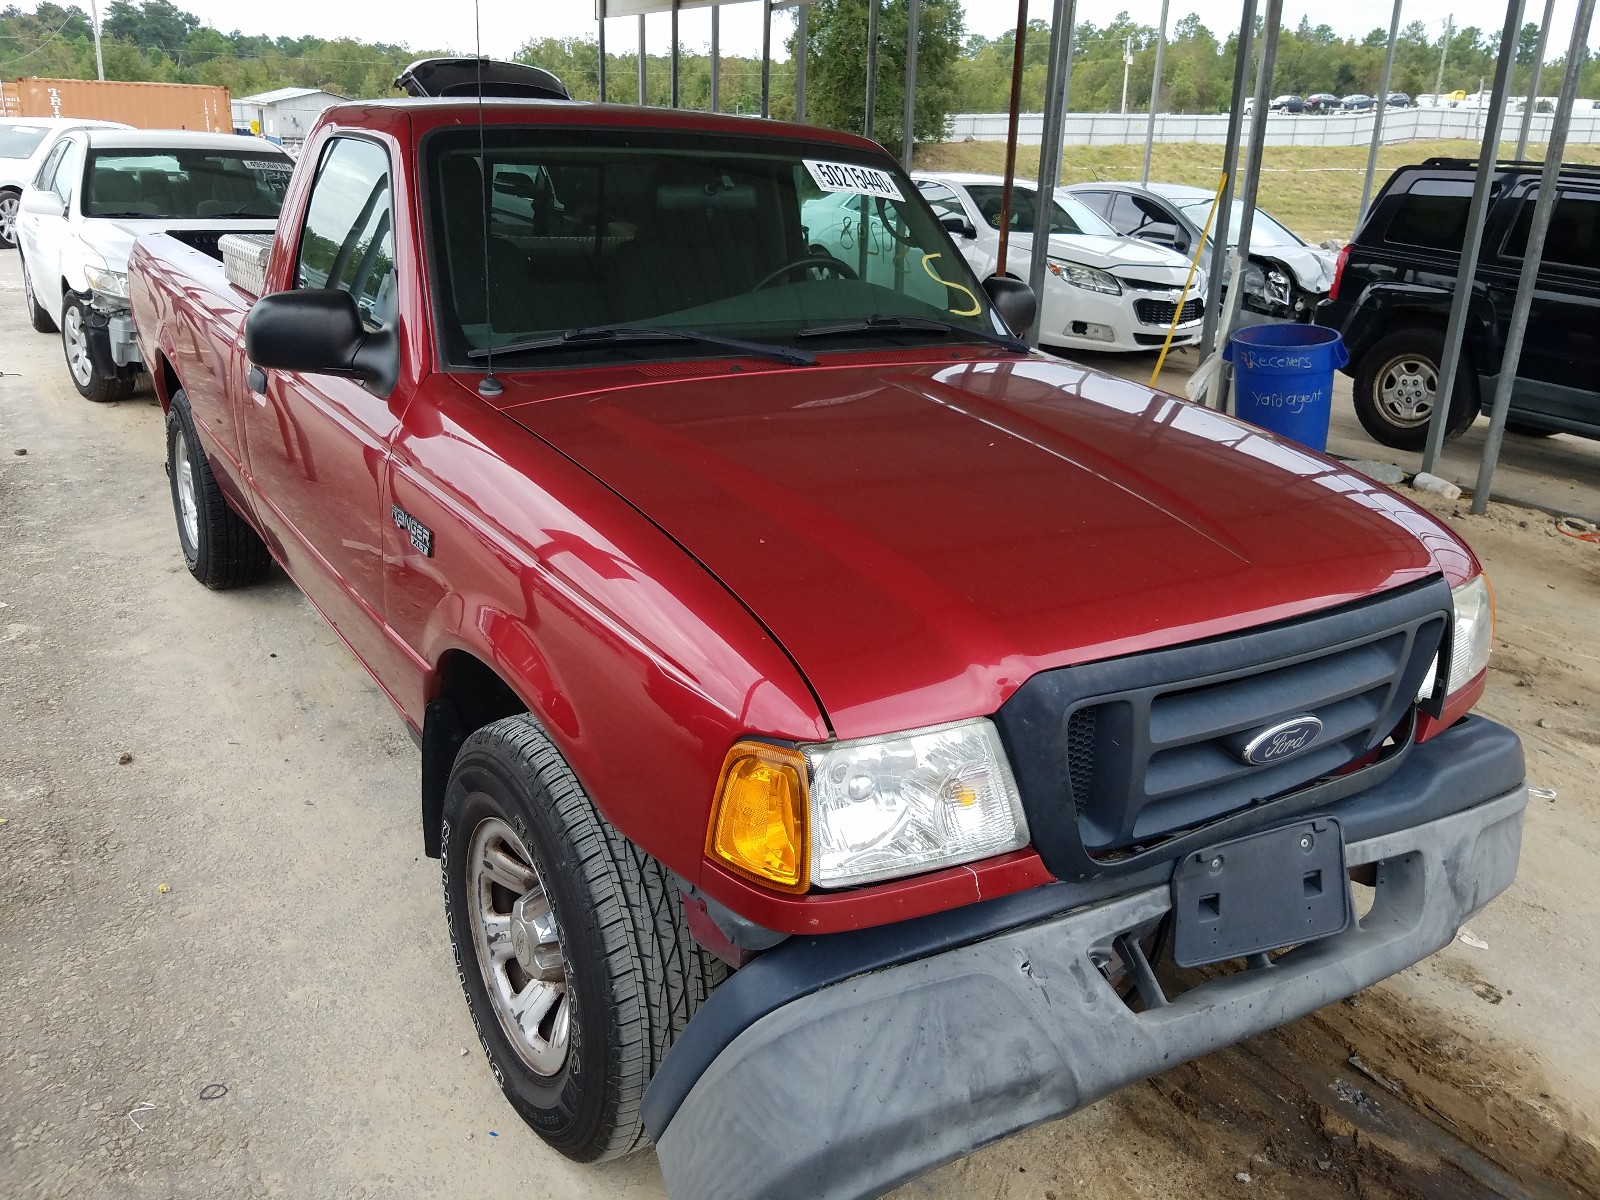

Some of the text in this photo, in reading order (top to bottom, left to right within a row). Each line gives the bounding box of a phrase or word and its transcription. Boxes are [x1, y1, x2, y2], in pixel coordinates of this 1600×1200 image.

[816, 163, 891, 193] 50215440
[1286, 389, 1323, 413] agent
[391, 504, 430, 547] RANGER
[1265, 728, 1309, 757] Ford
